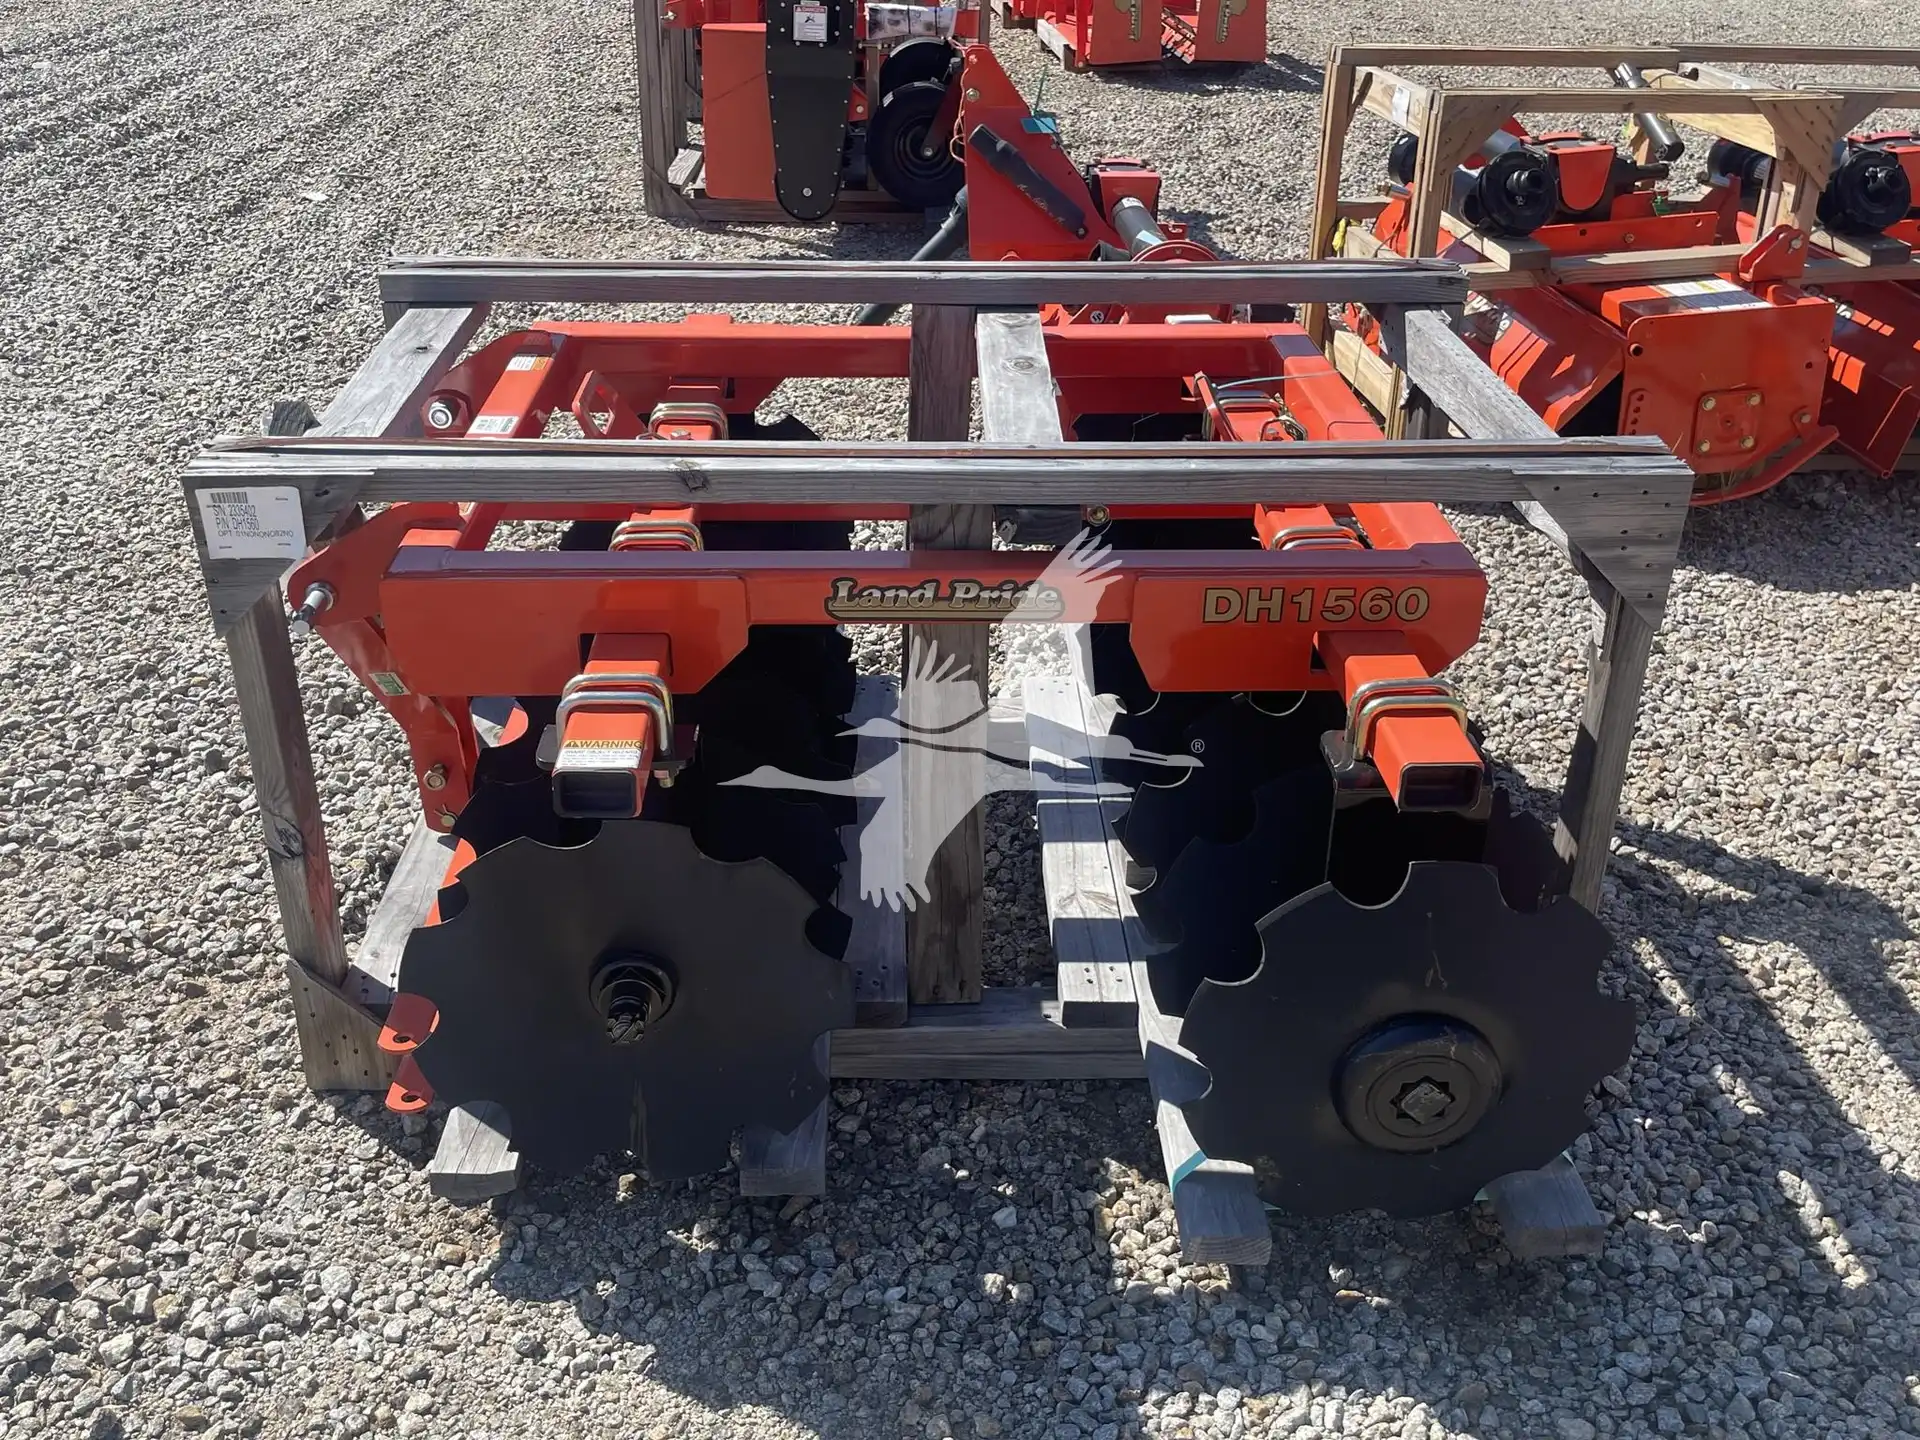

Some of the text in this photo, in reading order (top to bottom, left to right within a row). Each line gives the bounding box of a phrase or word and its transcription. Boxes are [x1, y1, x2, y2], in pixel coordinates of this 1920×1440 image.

[831, 580, 1060, 610] Land Pride
[1202, 587, 1429, 623] DH1560
[580, 740, 645, 749] WARNING
